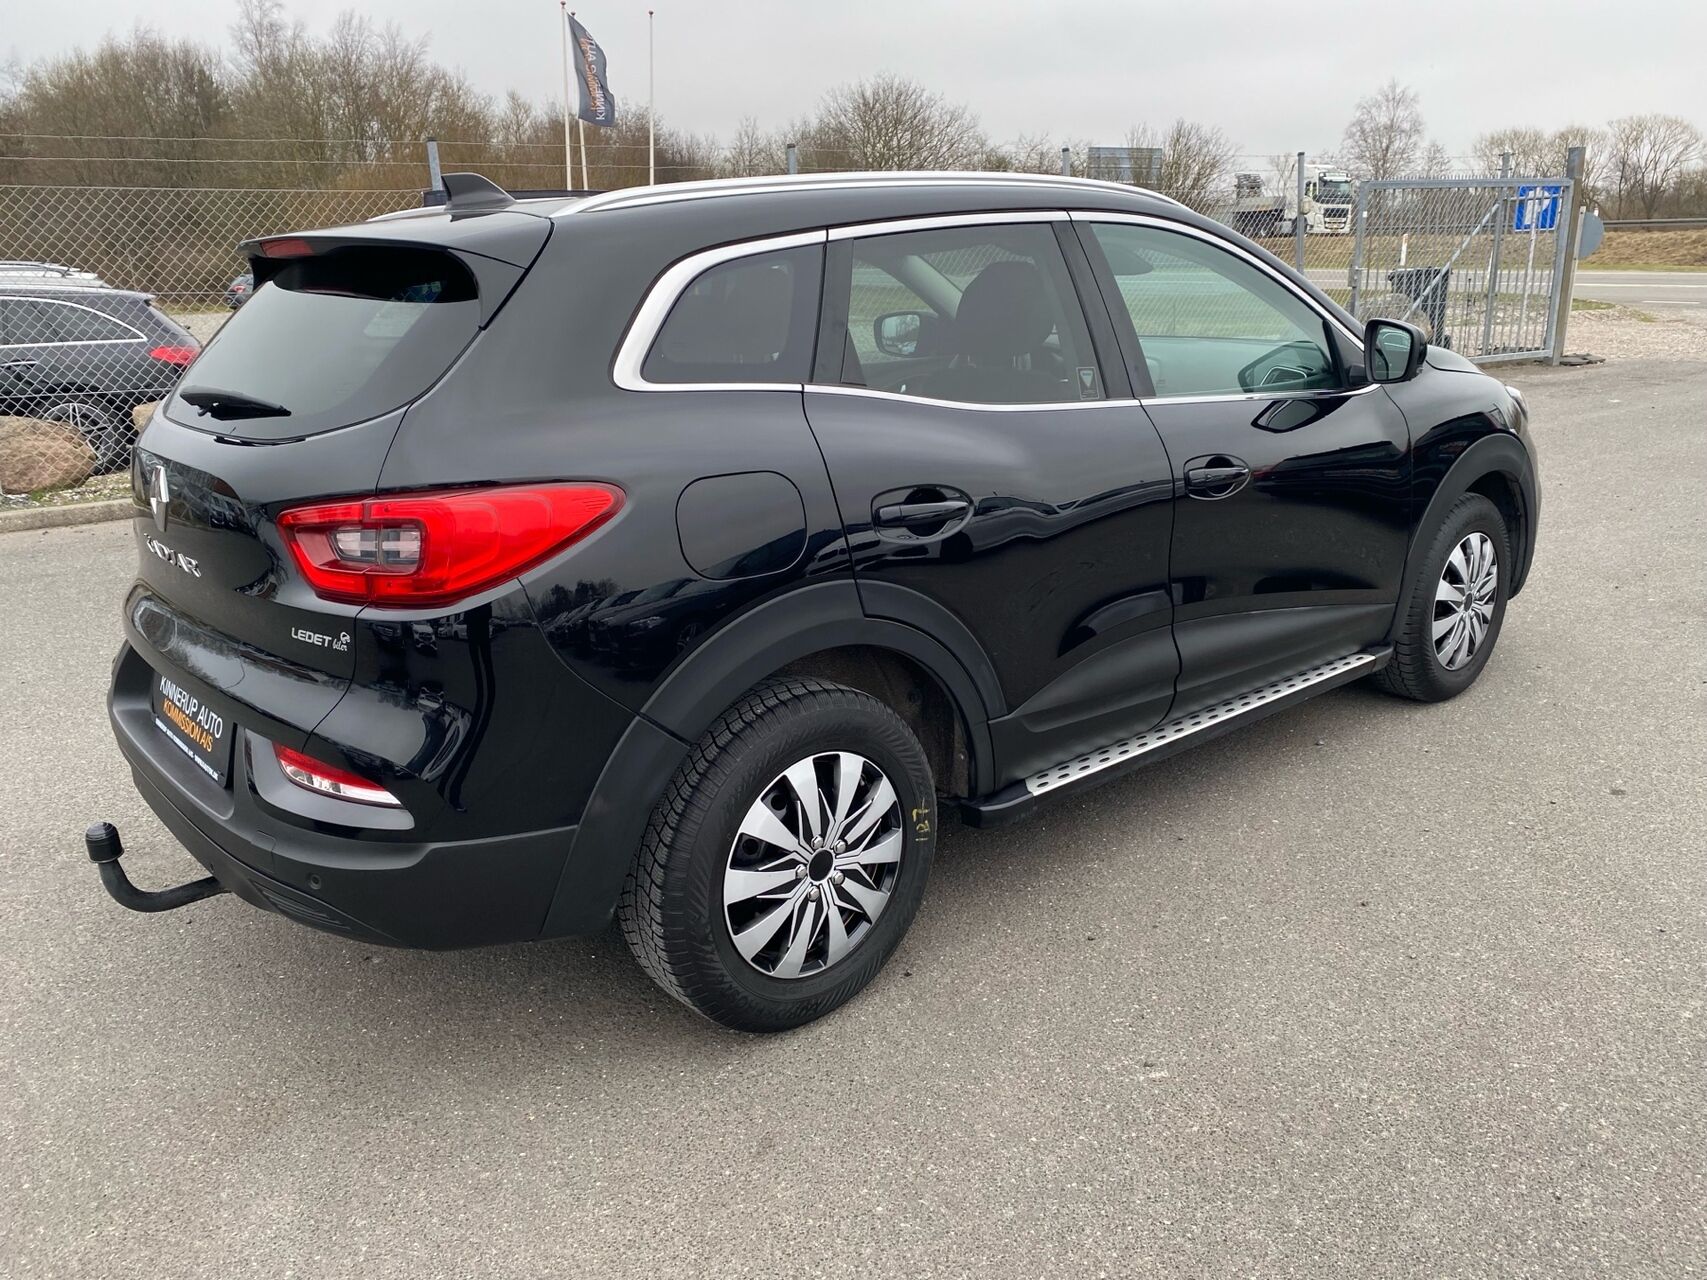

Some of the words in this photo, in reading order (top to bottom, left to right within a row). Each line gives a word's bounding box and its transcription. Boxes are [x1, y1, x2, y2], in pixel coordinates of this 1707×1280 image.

[291, 627, 332, 647] LEDET
[160, 676, 199, 717] KINNERUP
[197, 705, 223, 739] AUTO
[163, 698, 202, 743] KOMMISSION
